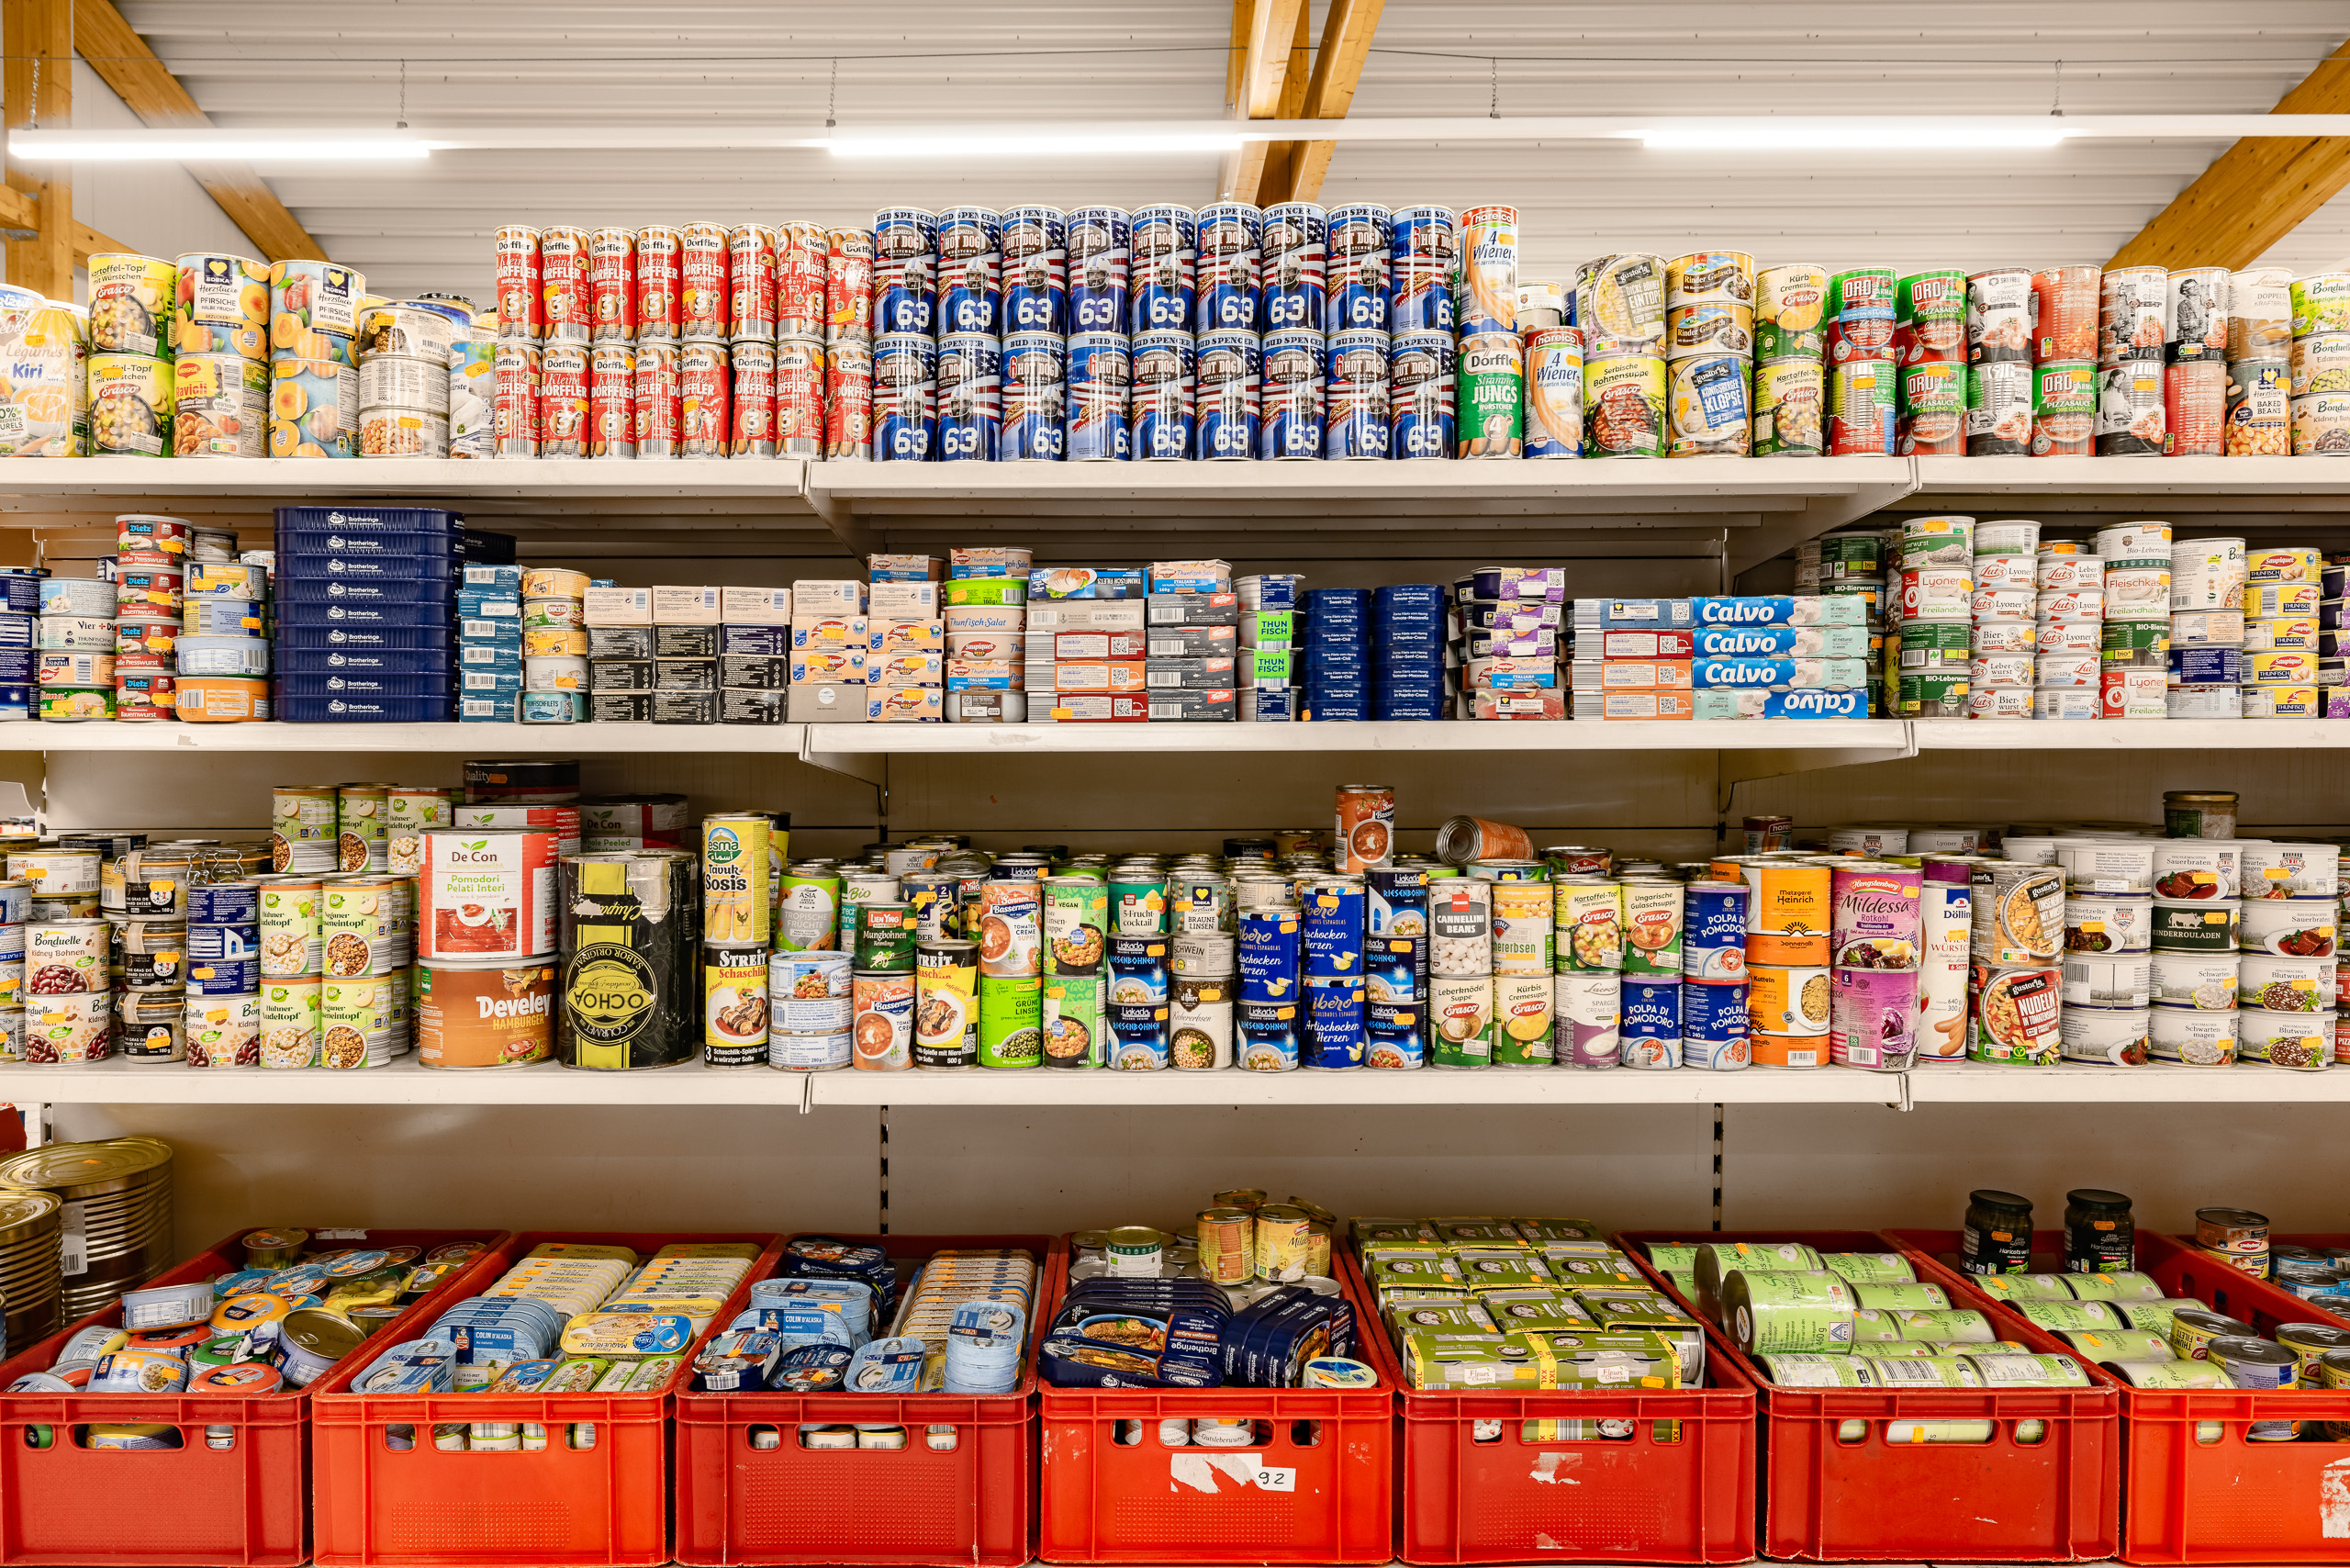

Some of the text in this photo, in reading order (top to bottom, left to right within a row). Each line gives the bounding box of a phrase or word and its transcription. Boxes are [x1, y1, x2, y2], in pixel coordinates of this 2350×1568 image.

[103, 273, 141, 282] Würstchen
[1684, 268, 1733, 283] Rinder Gulasch
[97, 285, 136, 298] Erasco
[199, 285, 239, 295] Herzstücke
[1845, 280, 1871, 297] ORO
[200, 297, 237, 307] PFIRSICHE
[1628, 290, 1662, 308] EINTOPF
[218, 305, 236, 313] FRUCHT
[1079, 298, 1113, 325] 63
[1918, 307, 1960, 316] PIZZASAUCE
[1134, 337, 1191, 348] BUD SPENCER
[1265, 337, 1323, 348] BUD SPENCER
[1552, 353, 1561, 366] 4
[13, 363, 43, 379] Kiri
[1139, 360, 1175, 375] HOT DOG
[1271, 360, 1309, 375] HOT DOG
[1537, 365, 1577, 381] Wiener
[1604, 364, 1639, 375] Serbische
[549, 374, 580, 385] Kleine
[1476, 375, 1515, 386] Stramme
[1594, 369, 1649, 387] Bohnensuppe
[175, 383, 207, 398] Ravioli
[1472, 386, 1517, 404] JUNGS
[1603, 386, 1641, 398] Erasco
[1706, 389, 1742, 413] KLOPSE
[2257, 399, 2281, 408] BAKED
[1153, 424, 1186, 451] 63
[1287, 424, 1319, 451] 63
[2266, 555, 2295, 565] Saupiquet
[2009, 568, 2031, 577] Lyoner
[1923, 577, 1960, 588] Lyoner
[1996, 600, 2021, 609] Lyoner
[1703, 601, 1774, 622] Calvo
[2109, 606, 2167, 615] Freilandhaltung
[78, 621, 95, 630] Vier
[1983, 631, 2004, 639] Bier-
[1704, 633, 1777, 653] Calvo
[1705, 664, 1776, 684] Calvo
[2130, 678, 2164, 688] Lyoner
[1785, 694, 1856, 713] Calvo
[709, 840, 740, 852] esma
[452, 852, 498, 862] De Con
[709, 863, 741, 876] Tavuk
[452, 874, 499, 883] Pomodori
[706, 875, 747, 891] Sosis
[447, 883, 505, 892] Pelati Interi
[1852, 879, 1899, 890] Hengstenberg
[1001, 894, 1030, 905] Sonnen
[1635, 892, 1673, 902] Ungarische
[1779, 890, 1812, 898] Metzgerei
[1630, 900, 1676, 910] Gulaschsuppe
[1777, 896, 1814, 904] Heinrich
[1841, 894, 1909, 914] Mildessa
[993, 902, 1037, 914] Bassermann
[1123, 909, 1155, 918] 5-Frucht-
[784, 911, 828, 921] TROPISCHE
[1437, 913, 1485, 924] CANNELLINI
[1638, 912, 1671, 924] Erasco
[1862, 914, 1888, 923] Rotkohl
[788, 919, 823, 929] FRÜCHTE
[1123, 918, 1152, 926] cocktail
[863, 929, 907, 940] Mungbohnen
[1447, 924, 1476, 934] BEANS
[2153, 929, 2221, 938] RINDERROULADEN
[35, 932, 81, 947] Bonduelle
[32, 947, 85, 958] Kidney Bohnen
[1173, 946, 1205, 957] SCHWEIN
[719, 966, 767, 979] Schaschlik
[1438, 984, 1485, 996] Leberknödel
[1516, 983, 1542, 993] Kürbis
[575, 991, 643, 1010] OCHOA
[1451, 993, 1472, 1002] Suppe
[1509, 991, 1548, 1001] Cremesuppe
[476, 991, 551, 1019] Develey
[1015, 999, 1038, 1008] GRÜNE
[1514, 1002, 1546, 1013] Erasco
[2019, 994, 2056, 1016] NUDELN
[1015, 1006, 1038, 1015] LINSEN
[1628, 1005, 1657, 1015] POLPA
[493, 1013, 544, 1031] HAMBURGER
[1305, 1021, 1360, 1032] Artischocken
[1624, 1014, 1674, 1028] POMODORO
[1316, 1032, 1349, 1043] Herzen
[1469, 1369, 1490, 1377] Fleurs
